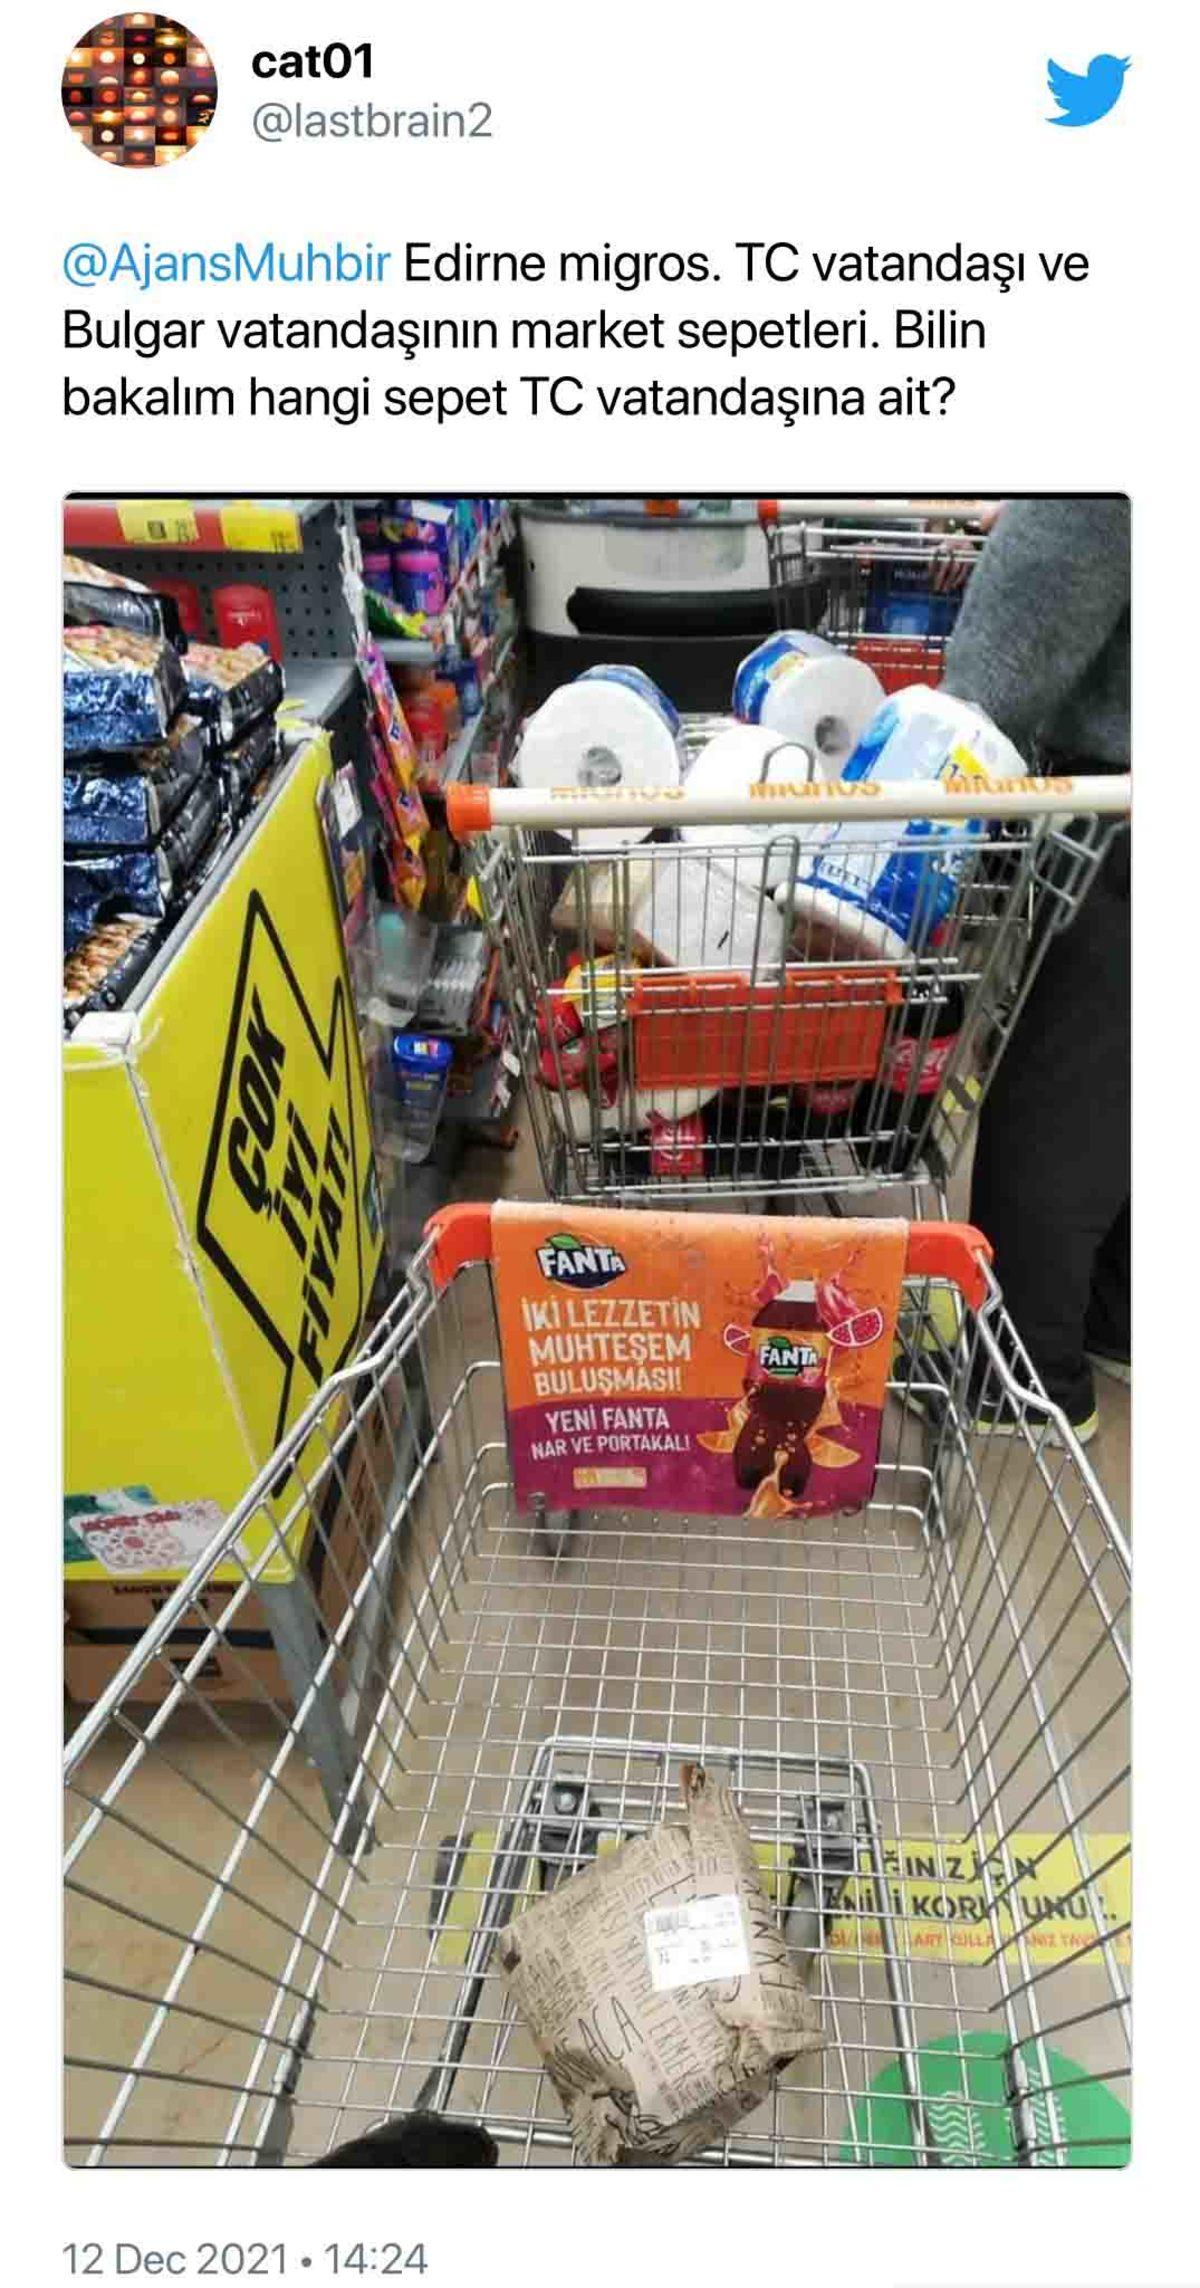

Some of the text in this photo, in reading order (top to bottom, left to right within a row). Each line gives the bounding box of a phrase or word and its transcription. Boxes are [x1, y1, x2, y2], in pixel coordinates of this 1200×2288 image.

[228, 983, 286, 1221] ÇOK
[273, 1099, 319, 1263] İYİ
[299, 1103, 350, 1389] FİYAT!
[536, 1246, 626, 1278] FANTA
[521, 1296, 702, 1332] İKİ LEZZETİN
[528, 1332, 692, 1367] MUHTEŞEM
[759, 1345, 819, 1367] FANTA
[533, 1366, 682, 1397] BULUŞMASI!
[545, 1404, 670, 1435] YENİ FANTA
[531, 1433, 690, 1461] NAR VE PORTAKAL!
